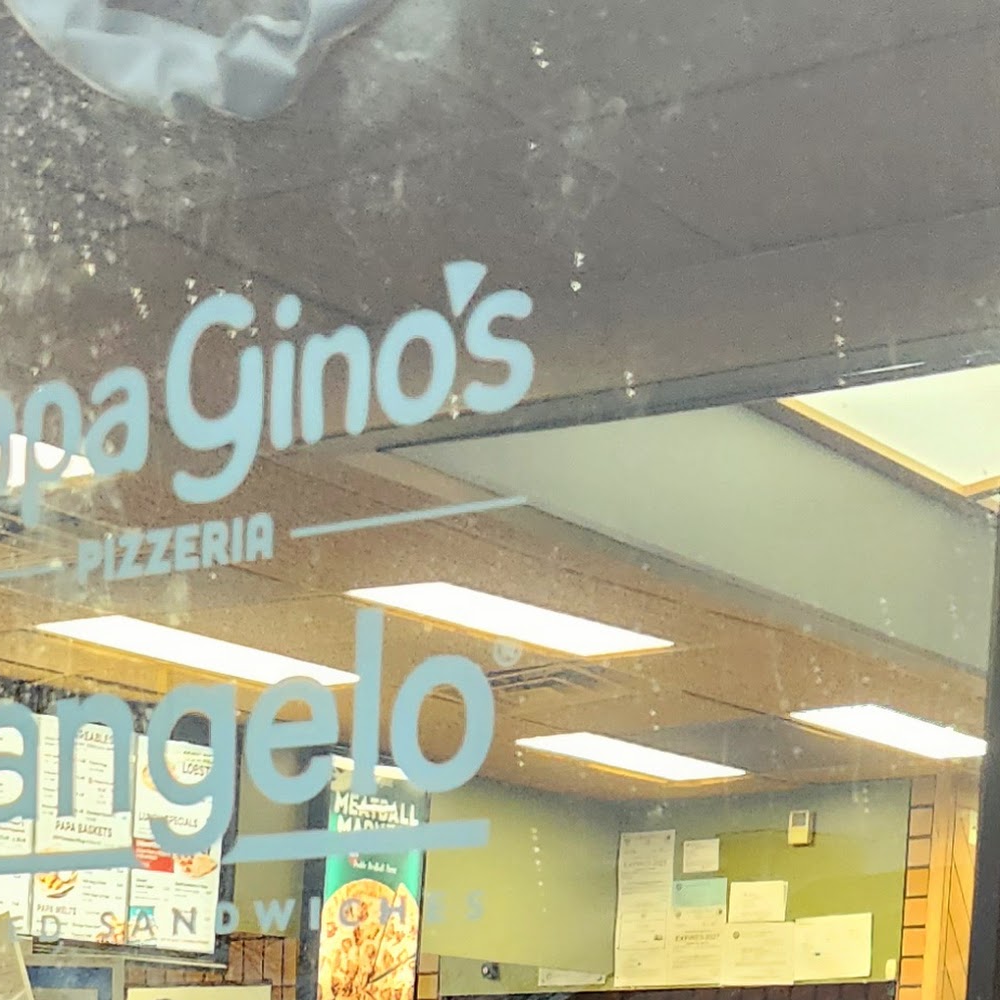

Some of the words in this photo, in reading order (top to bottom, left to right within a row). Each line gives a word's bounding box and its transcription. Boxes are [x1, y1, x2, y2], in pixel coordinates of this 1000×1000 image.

[77, 512, 275, 585] PIZZERIA
[334, 790, 419, 827] MEATBALL
[99, 887, 485, 938] SANDWICHES
